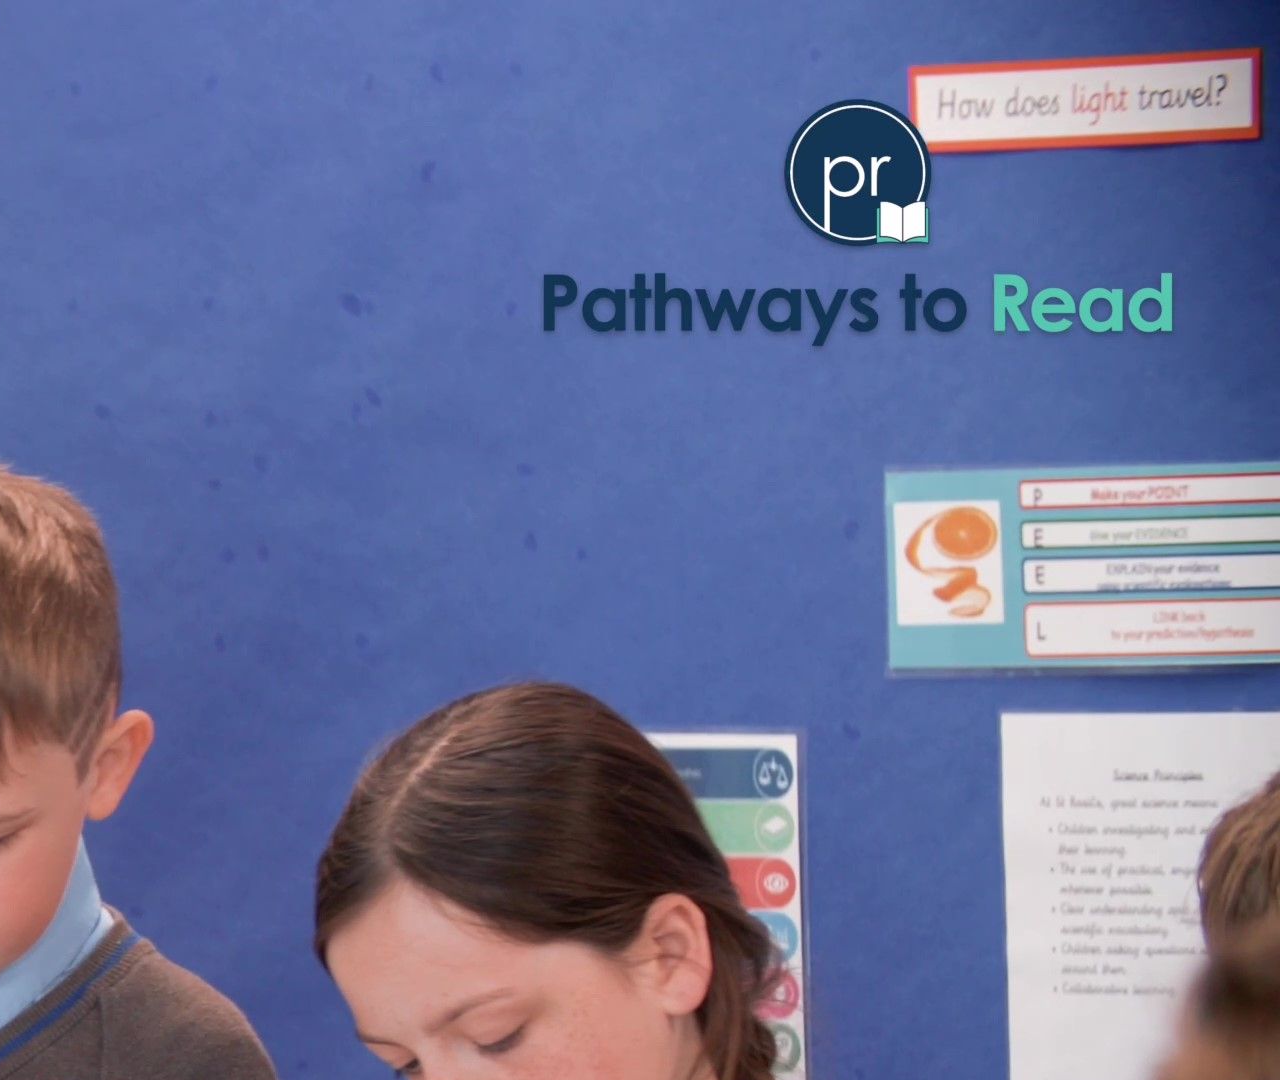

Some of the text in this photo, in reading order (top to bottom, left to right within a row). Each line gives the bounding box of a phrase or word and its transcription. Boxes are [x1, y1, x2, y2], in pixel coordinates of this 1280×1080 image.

[937, 73, 1228, 126] How does light travel?
[1034, 564, 1046, 586] E
[1037, 621, 1047, 642] L
